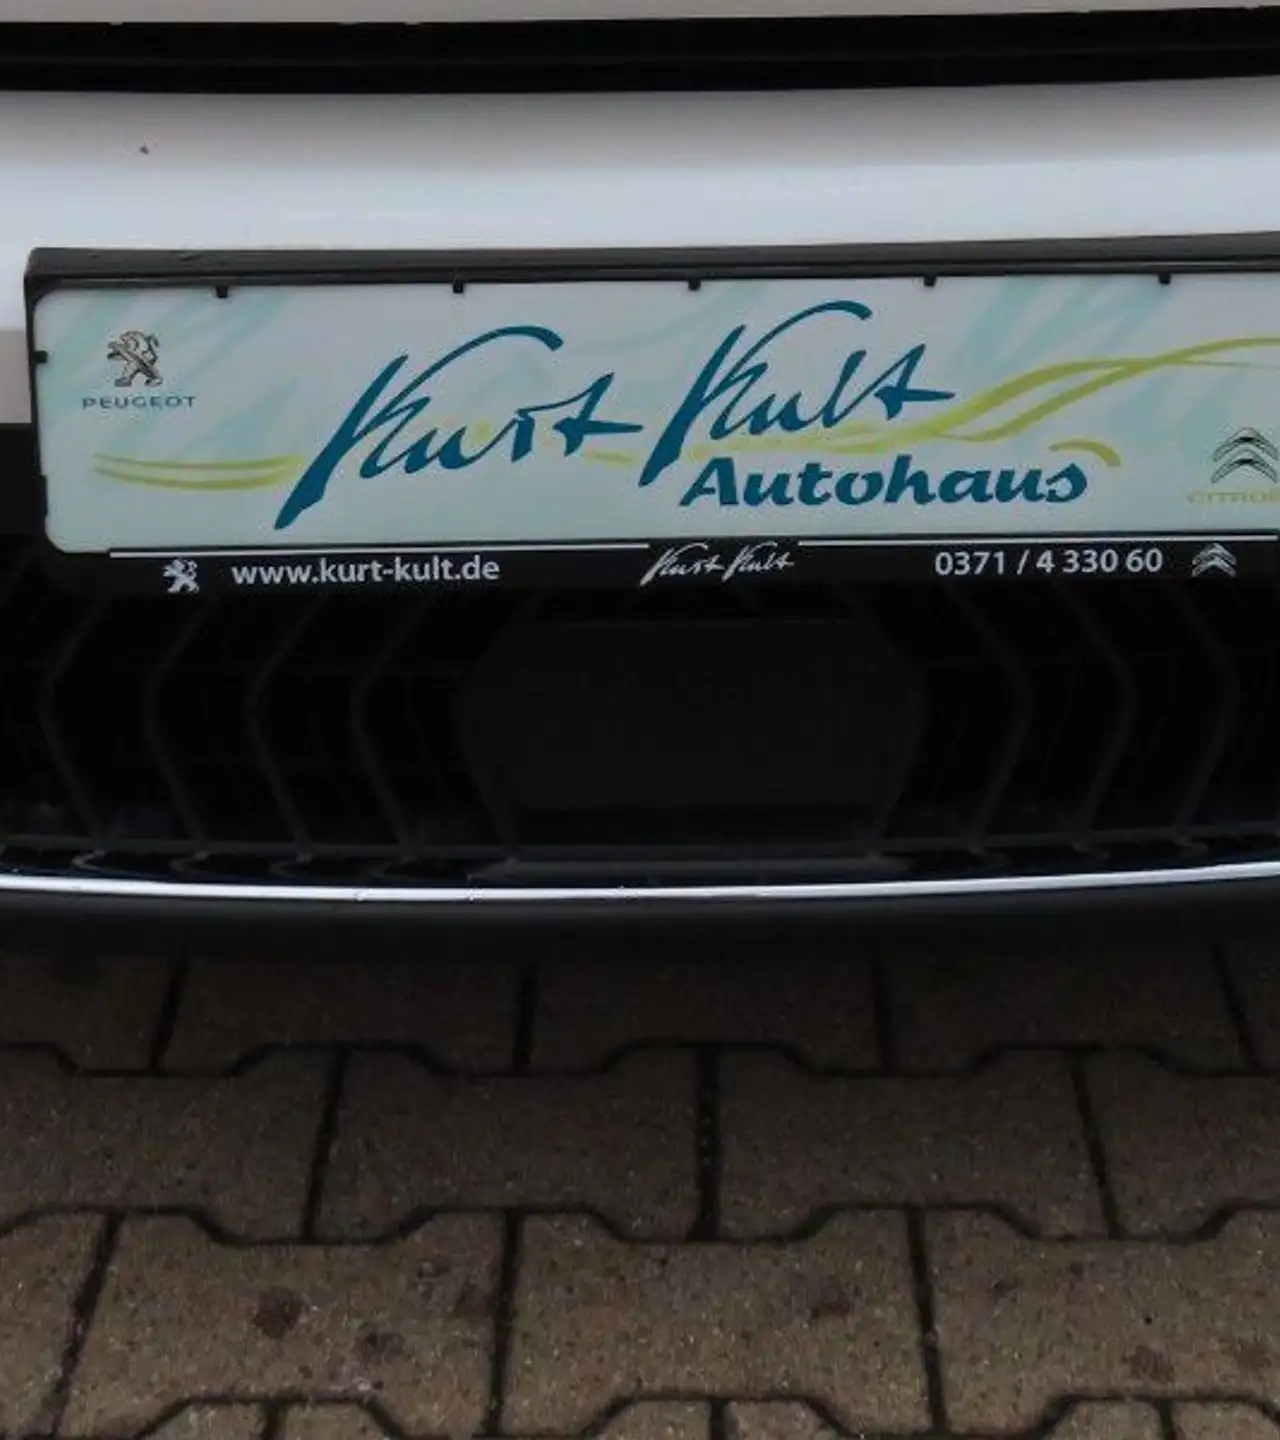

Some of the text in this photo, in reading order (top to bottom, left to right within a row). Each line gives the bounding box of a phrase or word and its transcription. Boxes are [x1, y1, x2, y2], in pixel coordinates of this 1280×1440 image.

[82, 394, 197, 410] PEUGEOT
[274, 300, 957, 531] Kurt Kult
[678, 453, 1088, 508] Autohaus
[231, 555, 501, 587] www.kurt-kult.de
[639, 542, 726, 587] Kurt
[933, 548, 1164, 576] 0371 / 4 330 60
